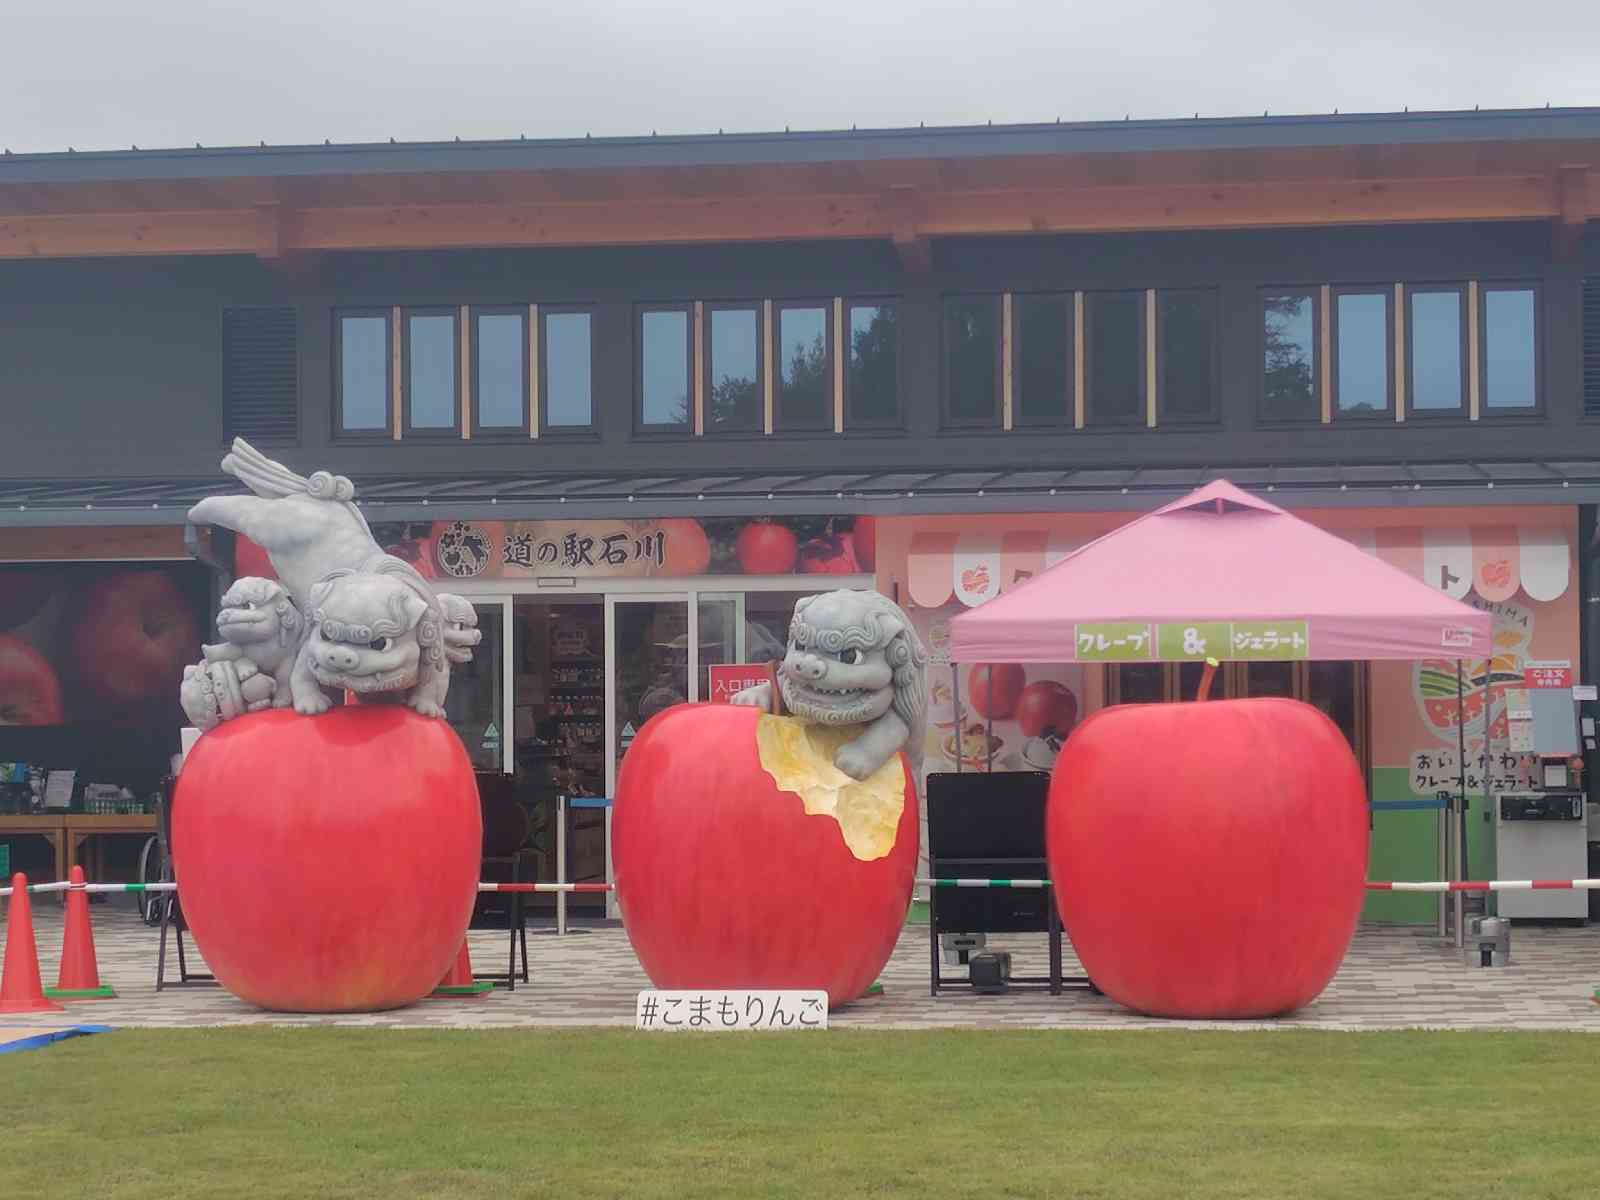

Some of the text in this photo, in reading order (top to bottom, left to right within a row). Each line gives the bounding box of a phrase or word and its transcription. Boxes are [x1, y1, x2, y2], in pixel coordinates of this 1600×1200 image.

[503, 531, 665, 568] 道の駅石川
[1078, 627, 1305, 655] クレープ & ジェラート
[640, 995, 824, 1026] #こまもりんご
